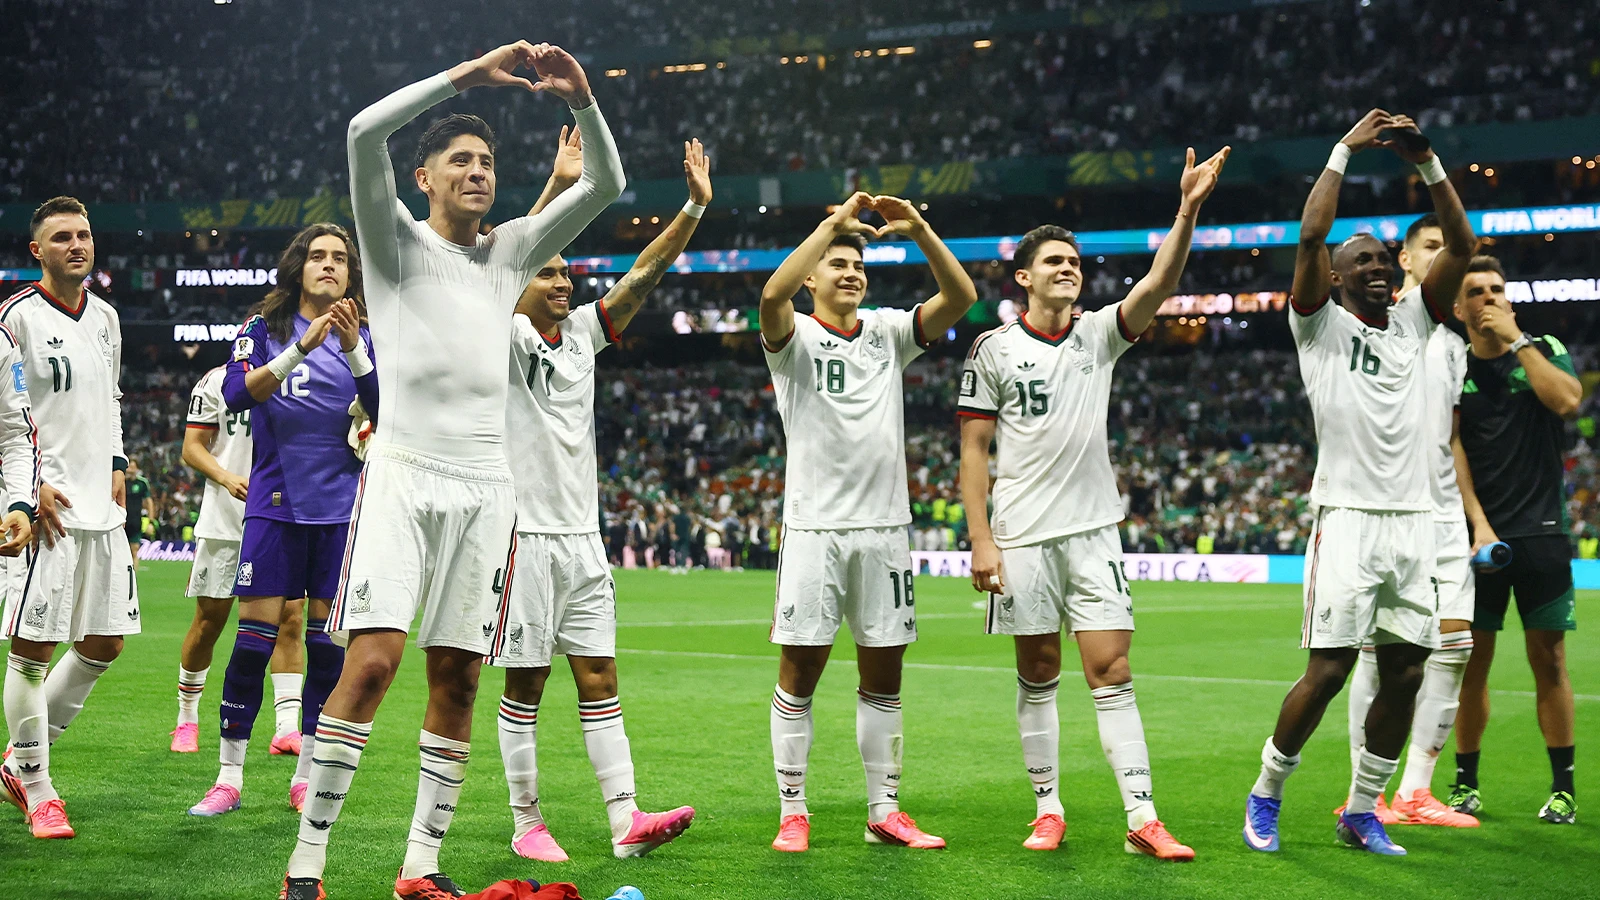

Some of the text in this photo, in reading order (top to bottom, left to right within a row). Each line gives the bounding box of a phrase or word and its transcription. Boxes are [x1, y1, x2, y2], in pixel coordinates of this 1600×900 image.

[1482, 206, 1600, 233] FIFA WORL
[176, 269, 211, 286] FIFA
[211, 268, 268, 286] WORLD
[1504, 278, 1600, 303] FA WORL
[1235, 291, 1288, 312] CITY
[174, 324, 210, 341] FIFA
[1350, 336, 1380, 376] 16
[48, 356, 72, 393] 11
[527, 353, 555, 396] 17
[814, 358, 845, 393] 18
[1015, 379, 1048, 417] 15
[136, 539, 195, 561] Michelo
[128, 565, 135, 600] 1
[1137, 560, 1213, 581] RICA
[889, 569, 914, 609] 18
[435, 802, 456, 812] MÉXI
